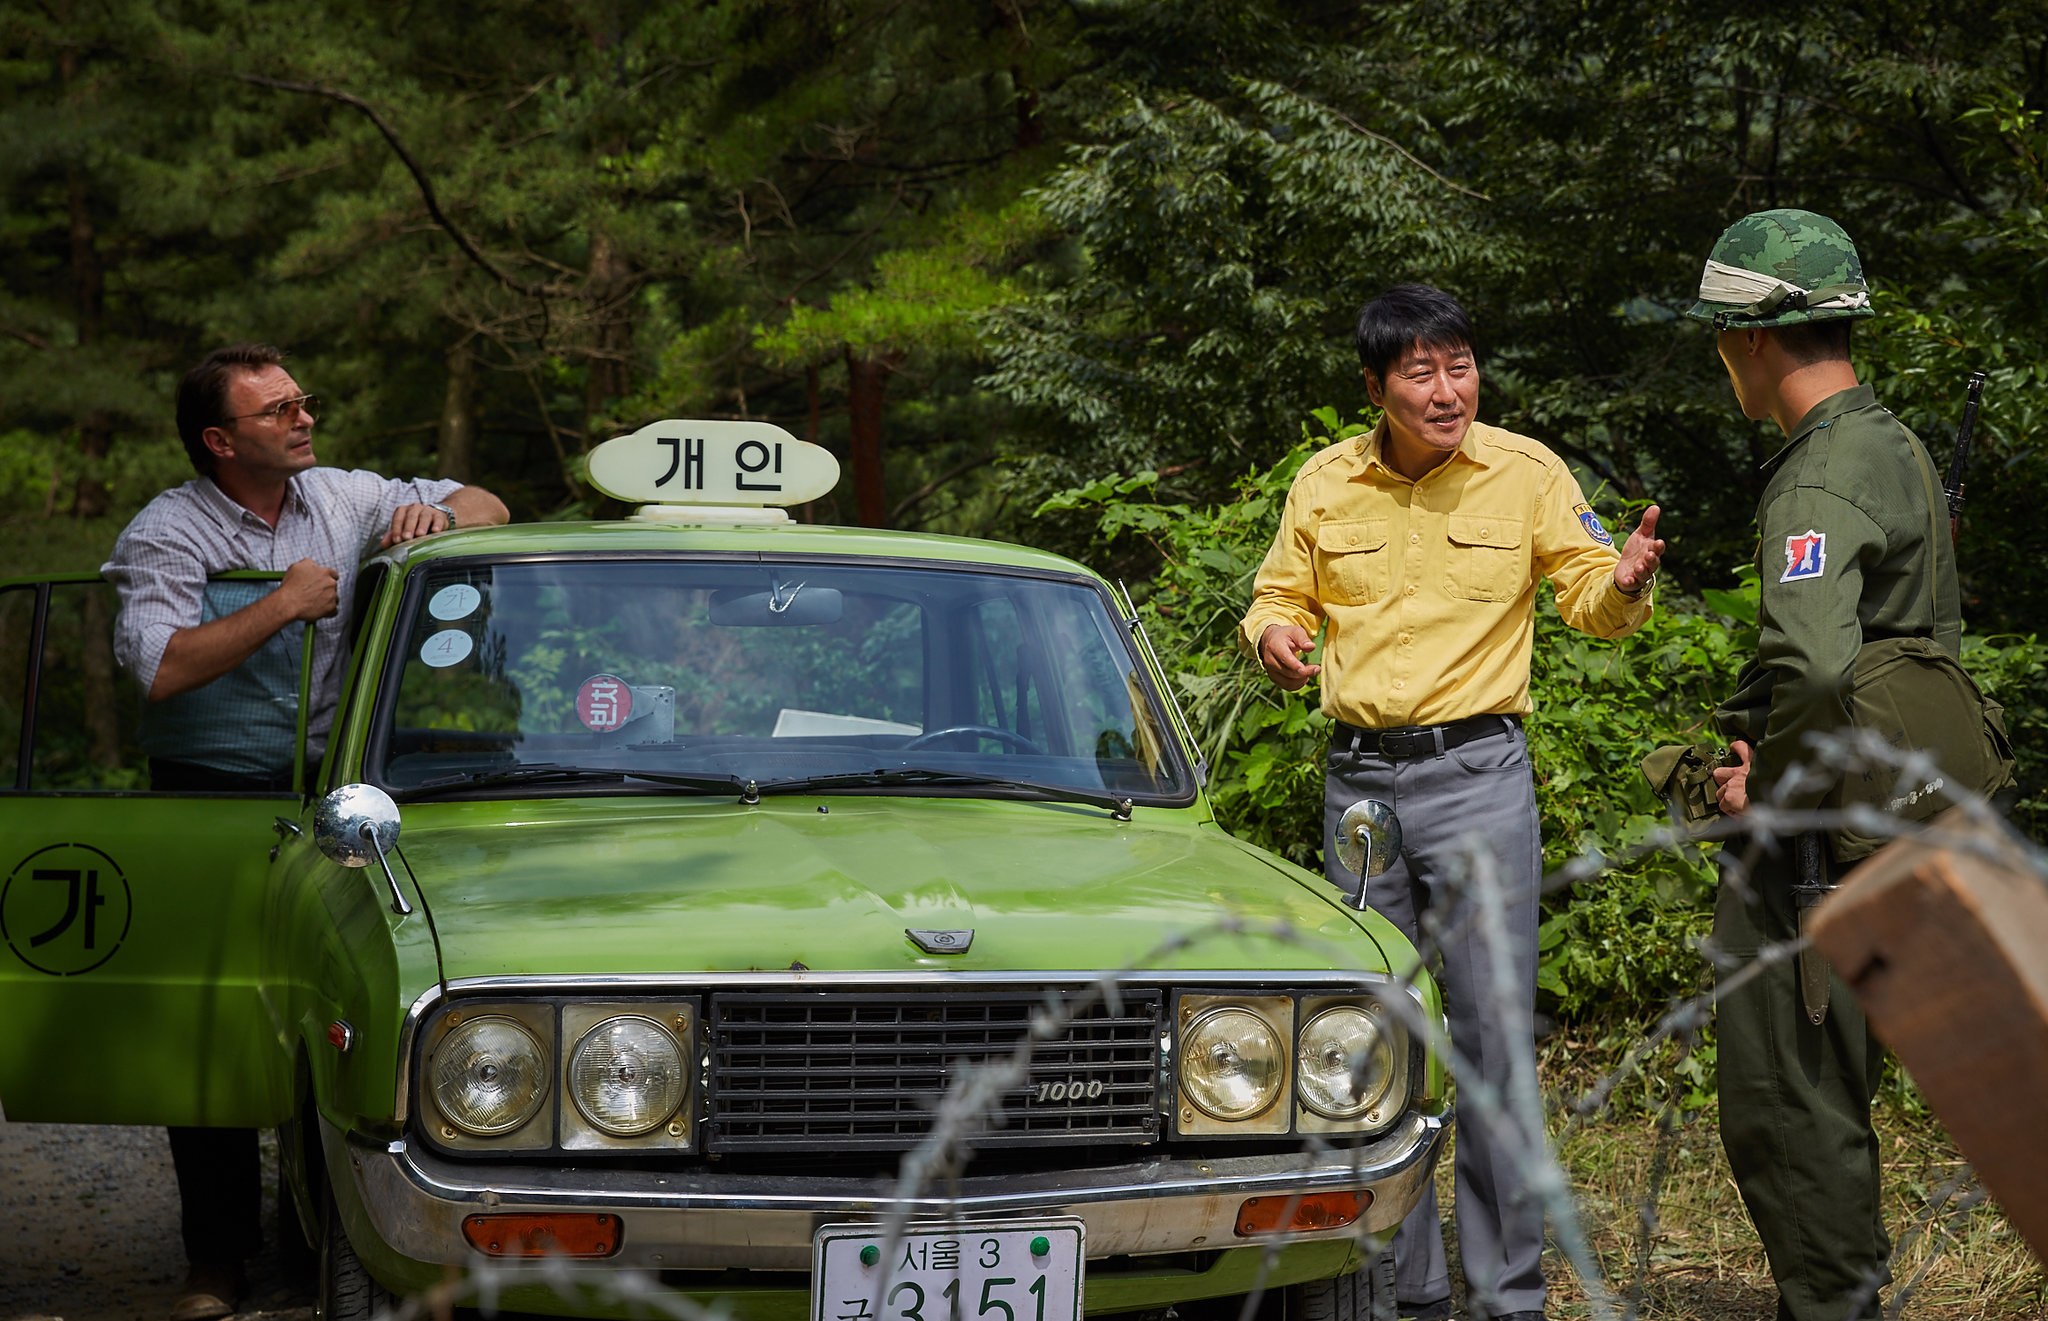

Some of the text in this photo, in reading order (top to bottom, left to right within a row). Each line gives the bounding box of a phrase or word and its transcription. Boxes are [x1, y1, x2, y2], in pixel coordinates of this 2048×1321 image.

[655, 437, 782, 491] 개인
[444, 592, 467, 608] 가
[437, 637, 453, 653] 4
[590, 682, 618, 726] 빈차
[30, 869, 105, 949] 가
[1039, 1079, 1103, 1102] 1000
[898, 1238, 1001, 1271] 서울 3
